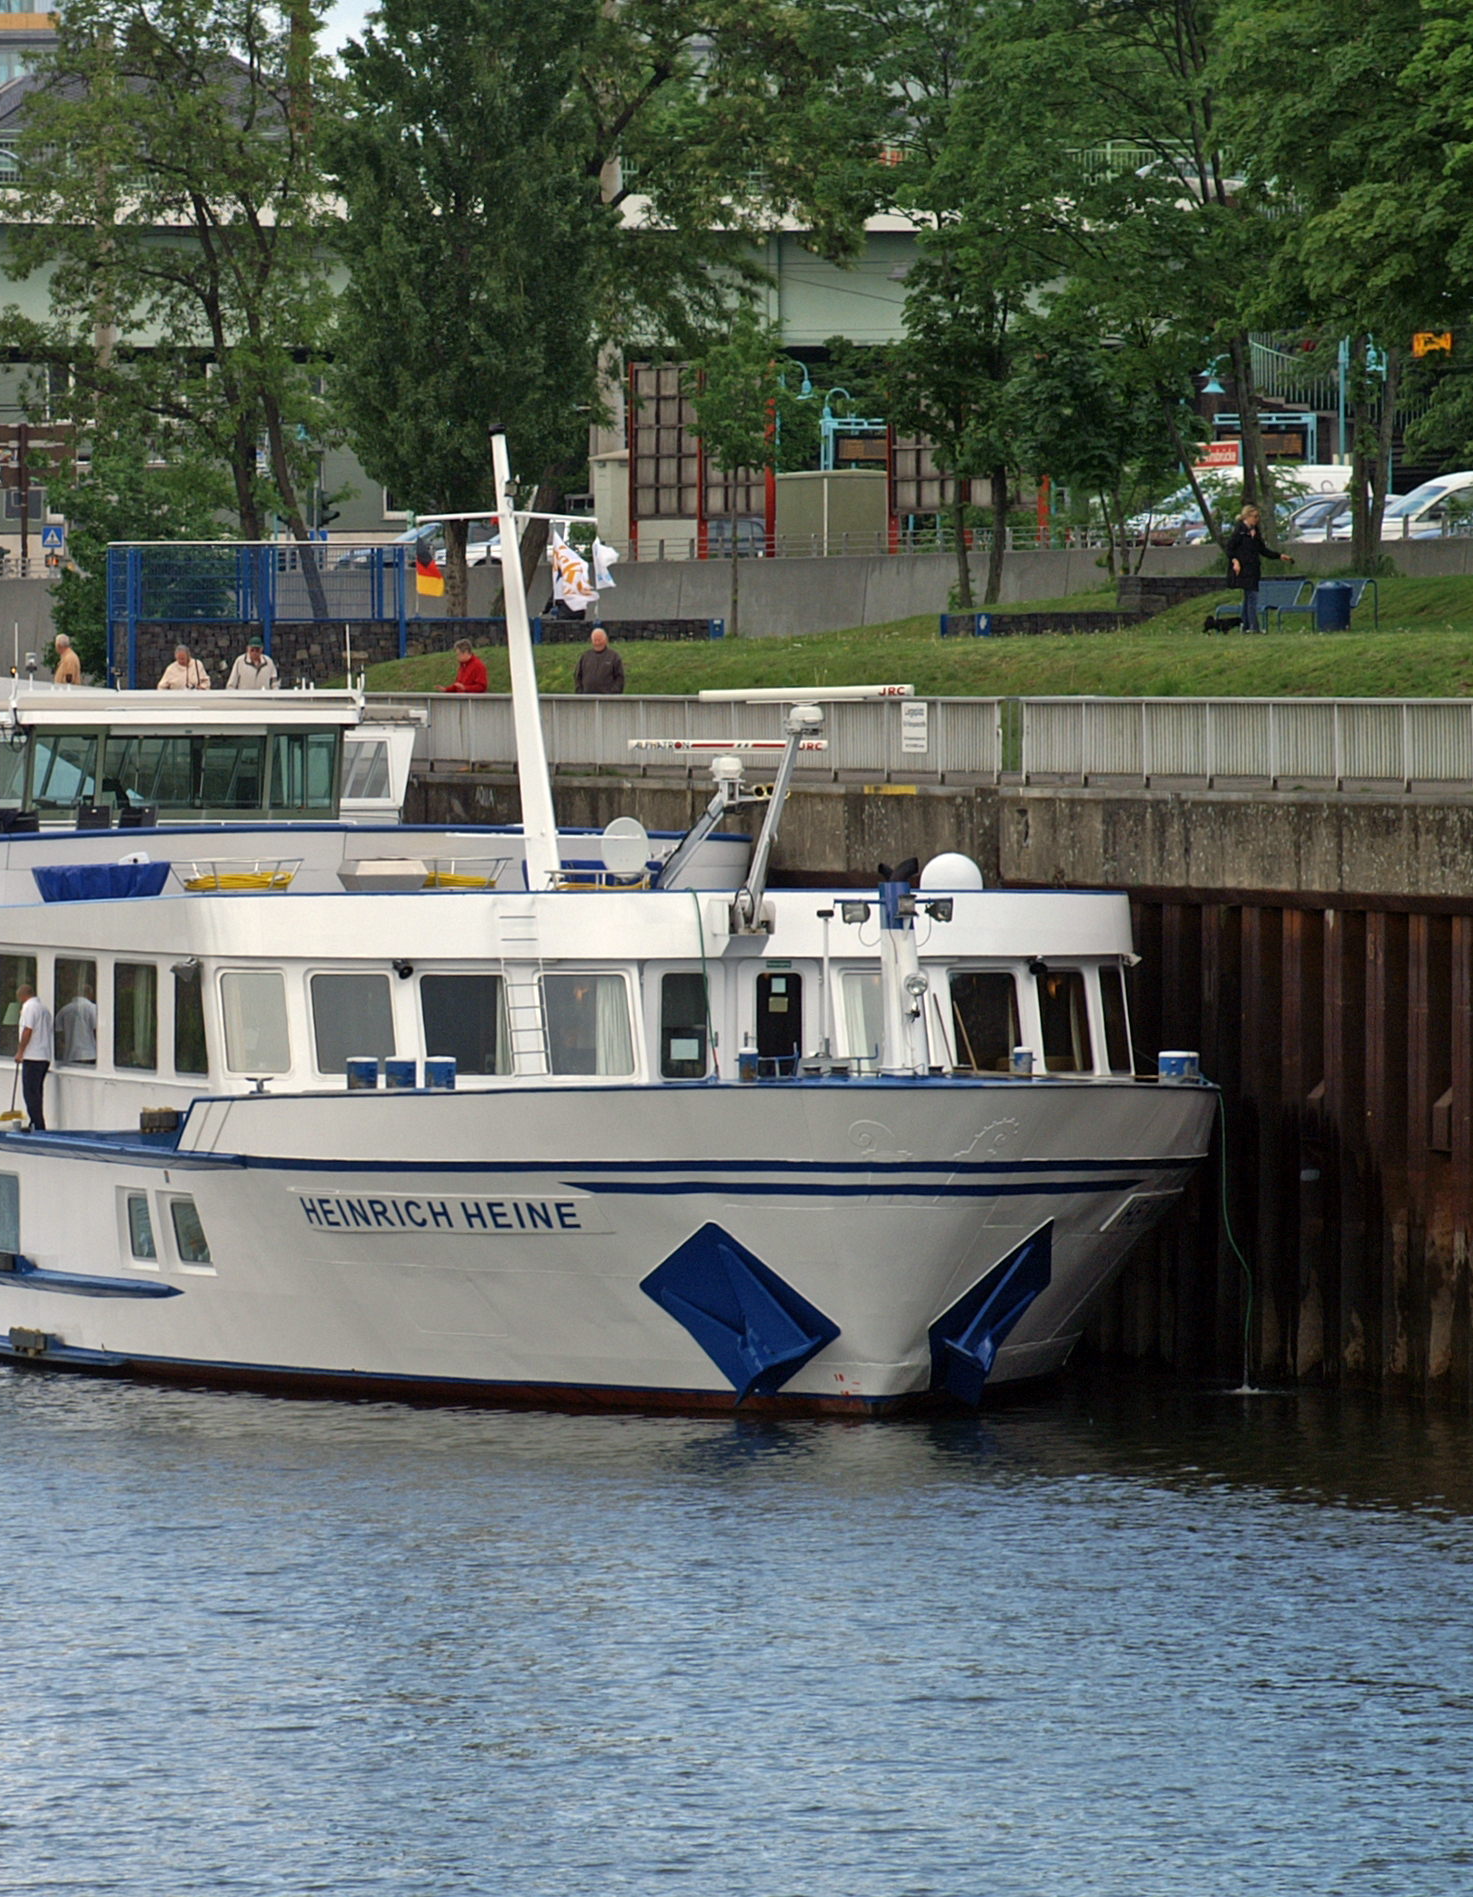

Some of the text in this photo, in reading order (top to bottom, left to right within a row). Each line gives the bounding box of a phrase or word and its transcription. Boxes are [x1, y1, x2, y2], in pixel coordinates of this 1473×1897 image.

[878, 686, 905, 696] JRC
[798, 742, 823, 751] JRC
[299, 1197, 582, 1229] HEINRICH HEINE
